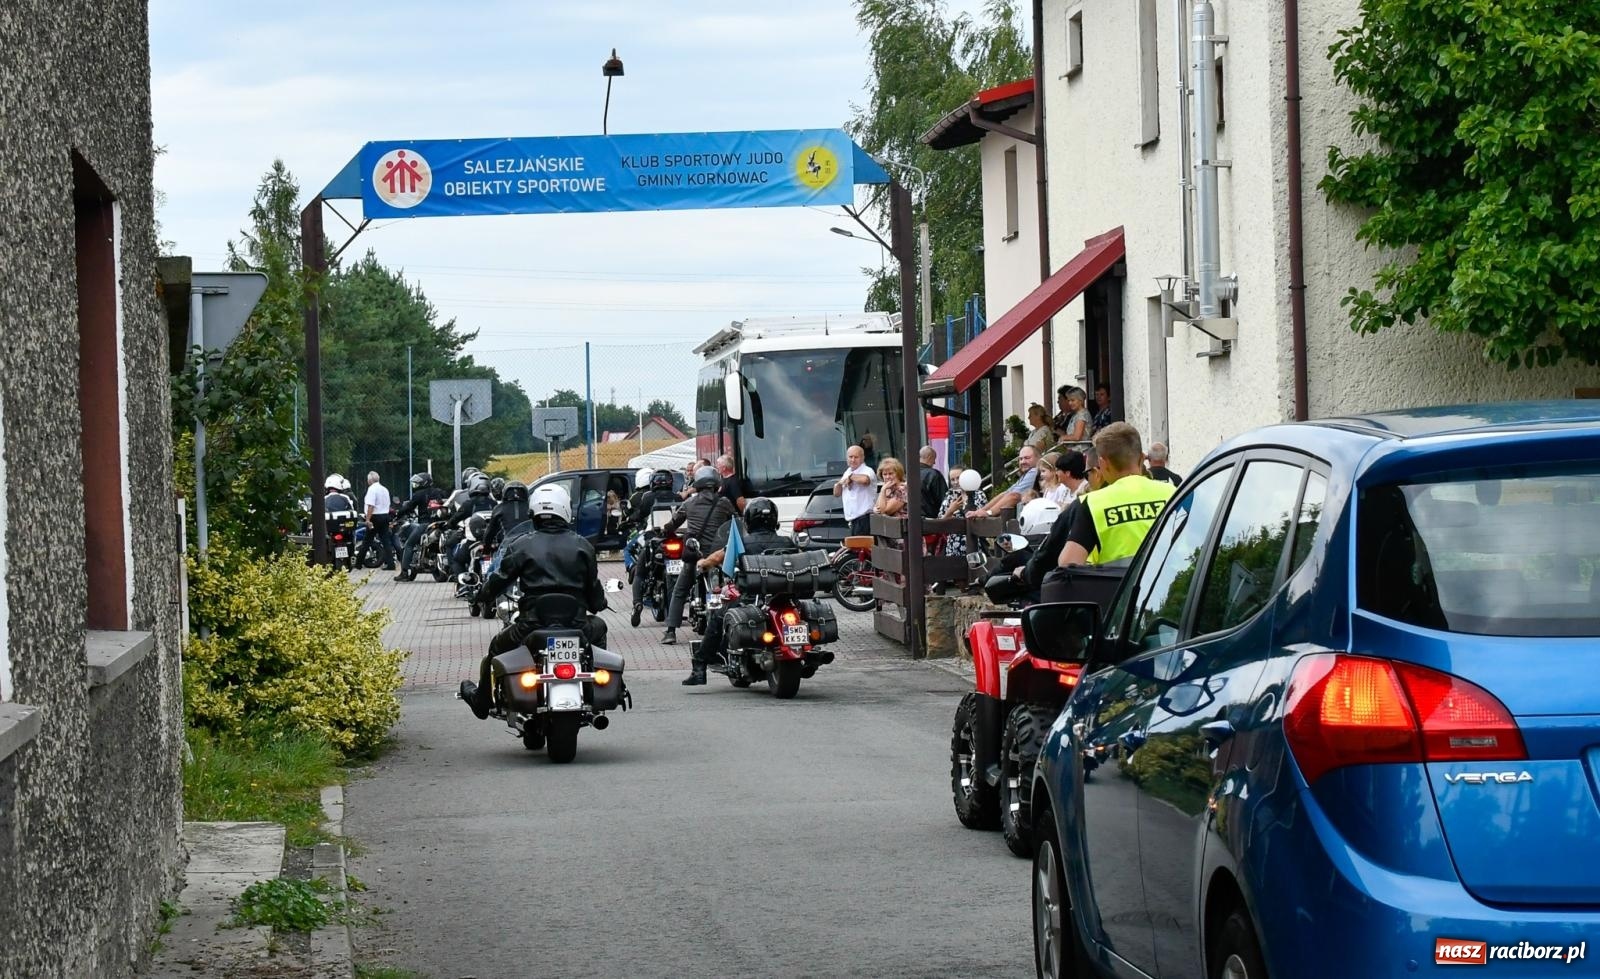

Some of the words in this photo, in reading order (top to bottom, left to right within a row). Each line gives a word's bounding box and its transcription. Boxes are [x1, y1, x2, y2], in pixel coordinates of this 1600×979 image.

[464, 155, 585, 174] SALEZJAŃSKIE
[621, 155, 659, 168] KLUB
[664, 153, 742, 167] SPORTOWY
[746, 152, 783, 165] JUDO
[444, 180, 512, 196] OBIEKTY
[517, 178, 606, 194] SPORTOWE
[638, 174, 682, 187] GMINY
[688, 171, 768, 186] KORNOWAC
[555, 640, 574, 649] SWD
